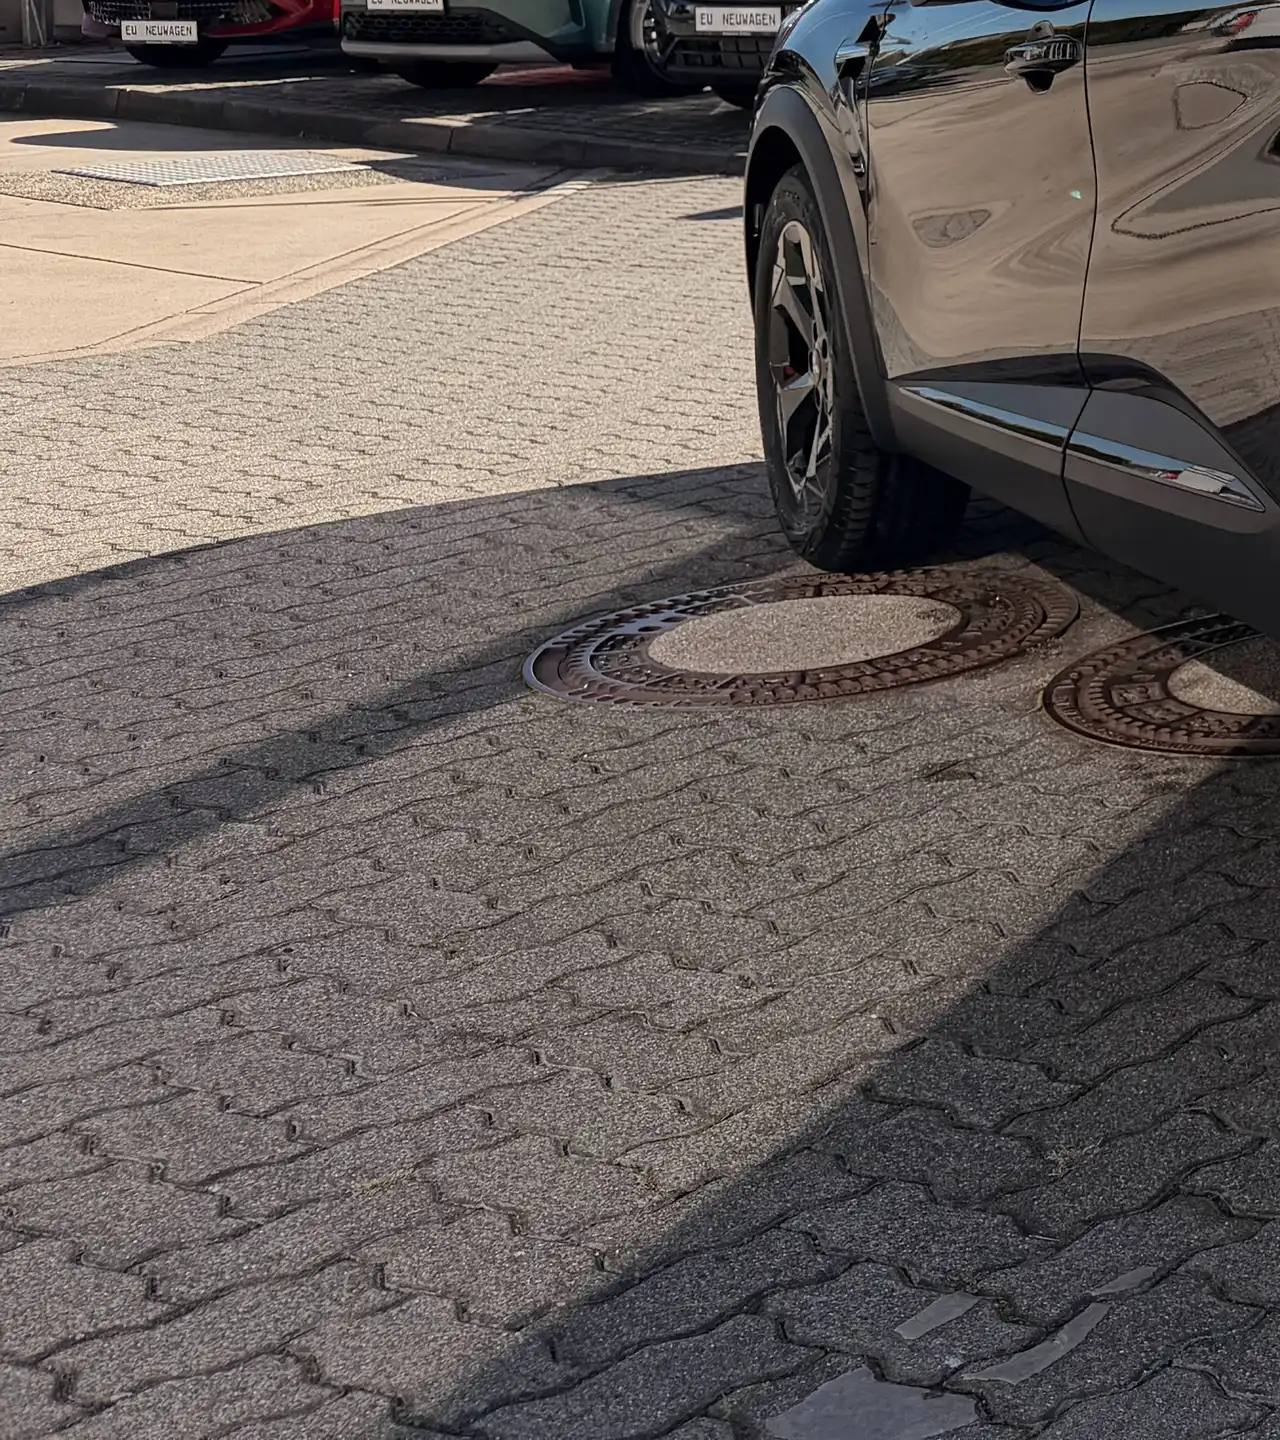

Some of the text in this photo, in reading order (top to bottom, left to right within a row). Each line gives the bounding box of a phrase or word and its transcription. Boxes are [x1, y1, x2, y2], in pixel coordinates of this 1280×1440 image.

[701, 13, 776, 26] EU NEUWAGEN
[126, 25, 192, 37] EU NEUWAGEN
